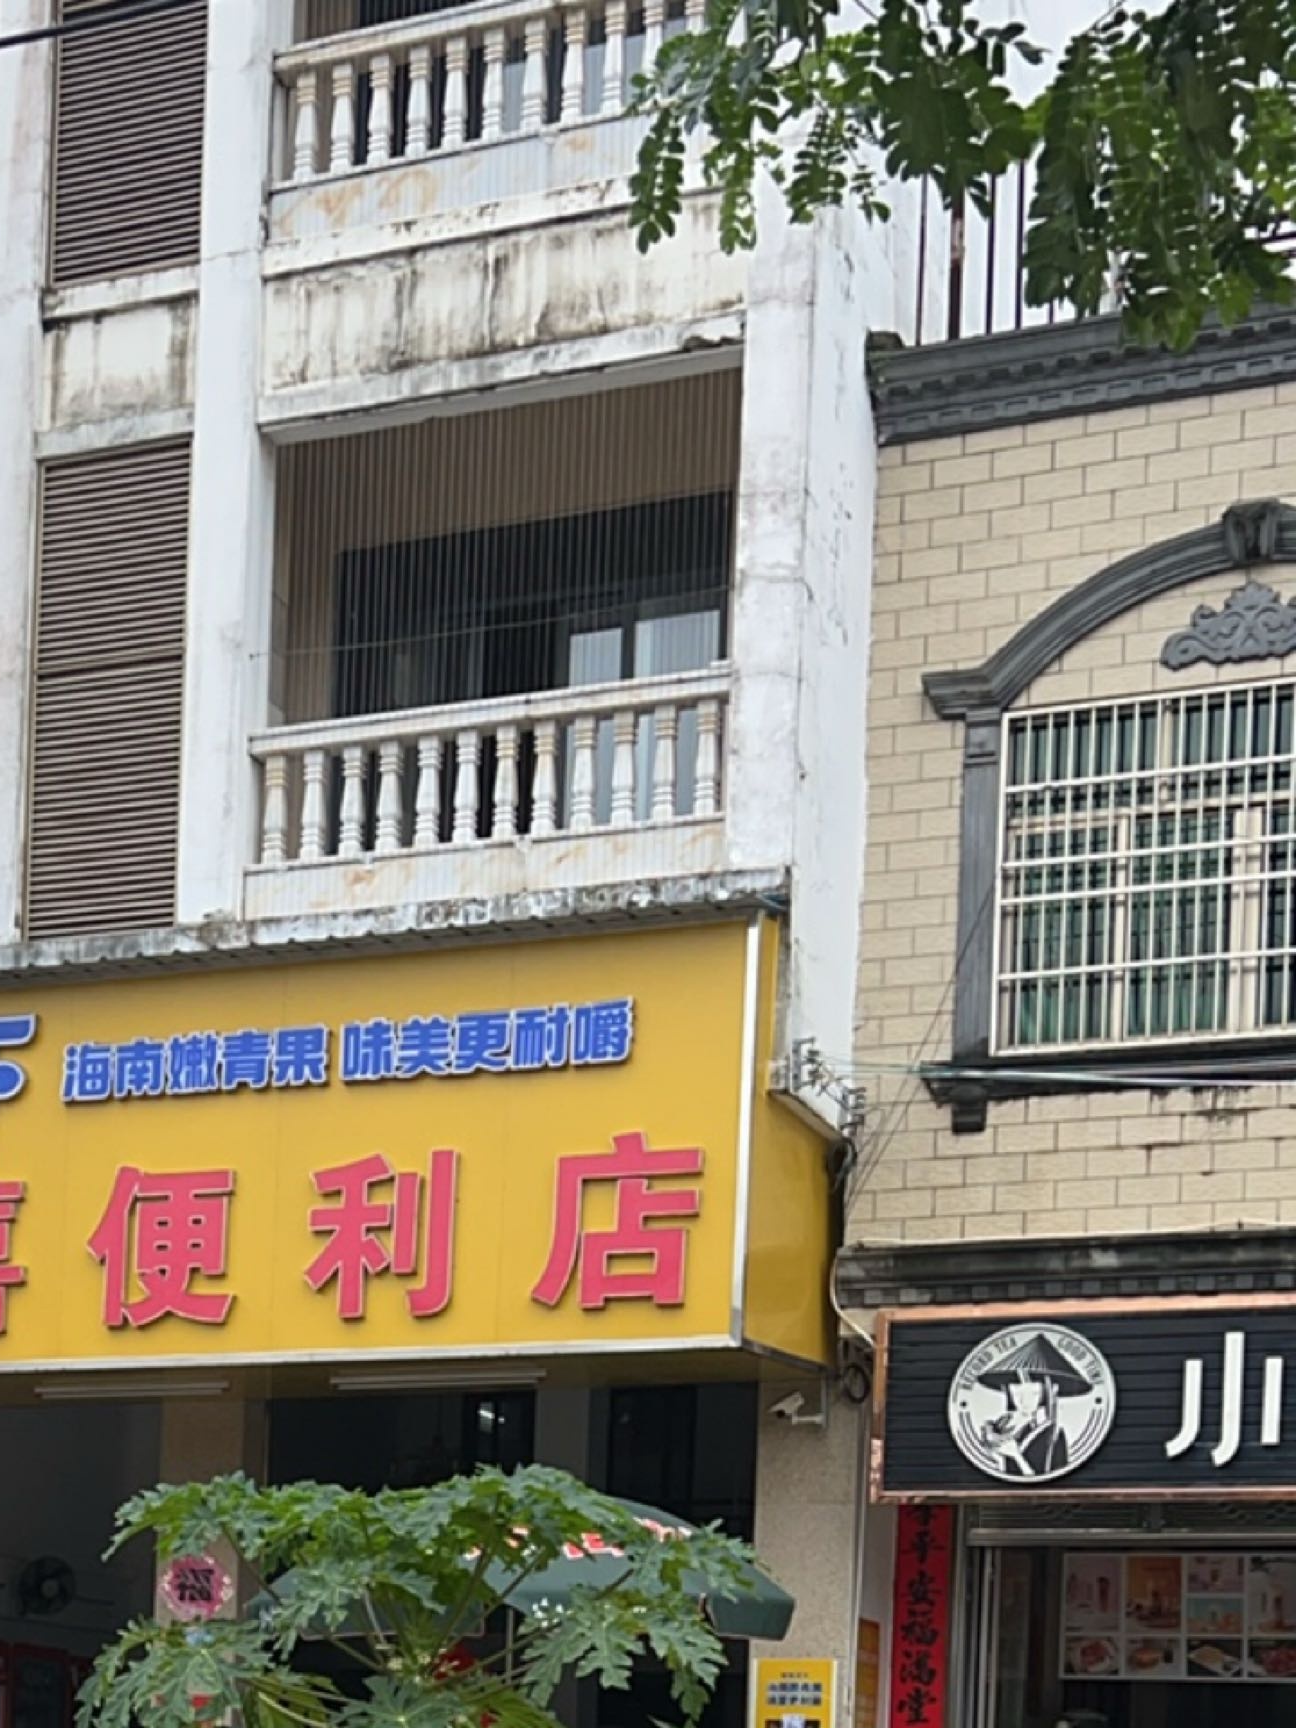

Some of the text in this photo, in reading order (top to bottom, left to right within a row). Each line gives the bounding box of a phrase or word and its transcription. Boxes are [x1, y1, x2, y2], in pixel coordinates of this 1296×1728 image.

[62, 997, 635, 1102] 海南嫩青果 味美更耐嚼
